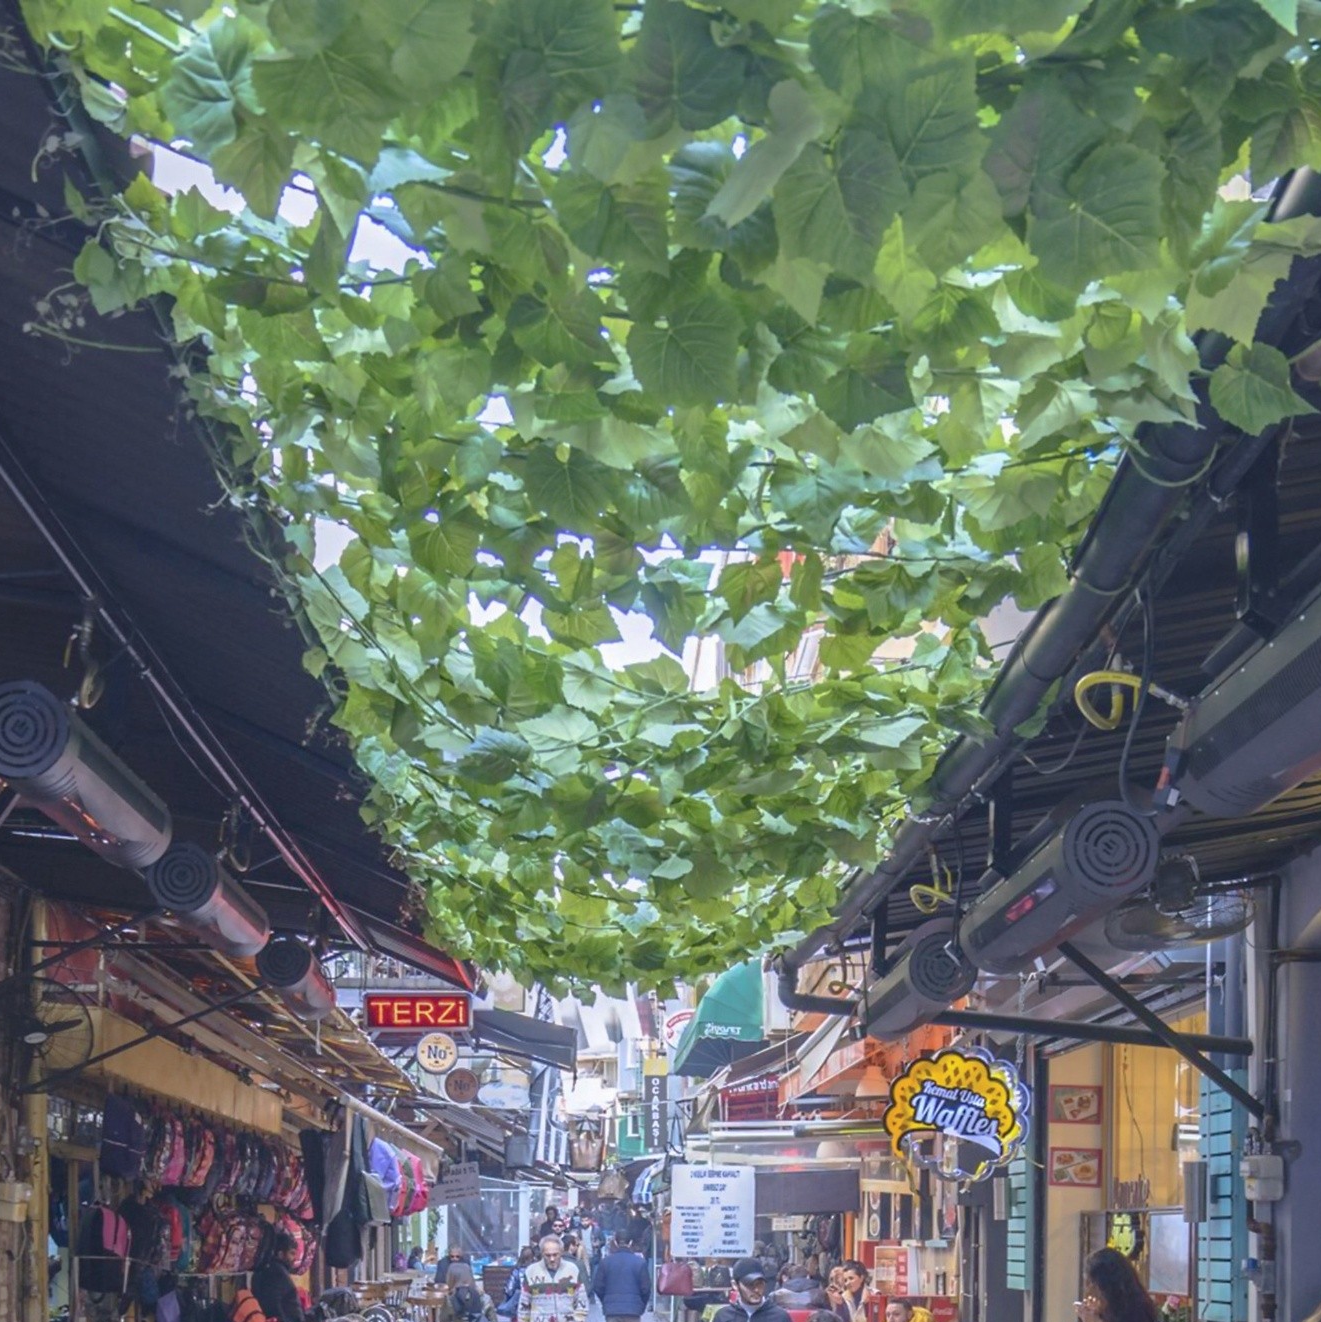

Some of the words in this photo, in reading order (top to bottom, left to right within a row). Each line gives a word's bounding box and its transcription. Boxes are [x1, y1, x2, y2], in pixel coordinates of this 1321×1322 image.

[923, 1080, 958, 1100] Kemal
[959, 1091, 985, 1108] Usta
[911, 1094, 998, 1137] Waffles
